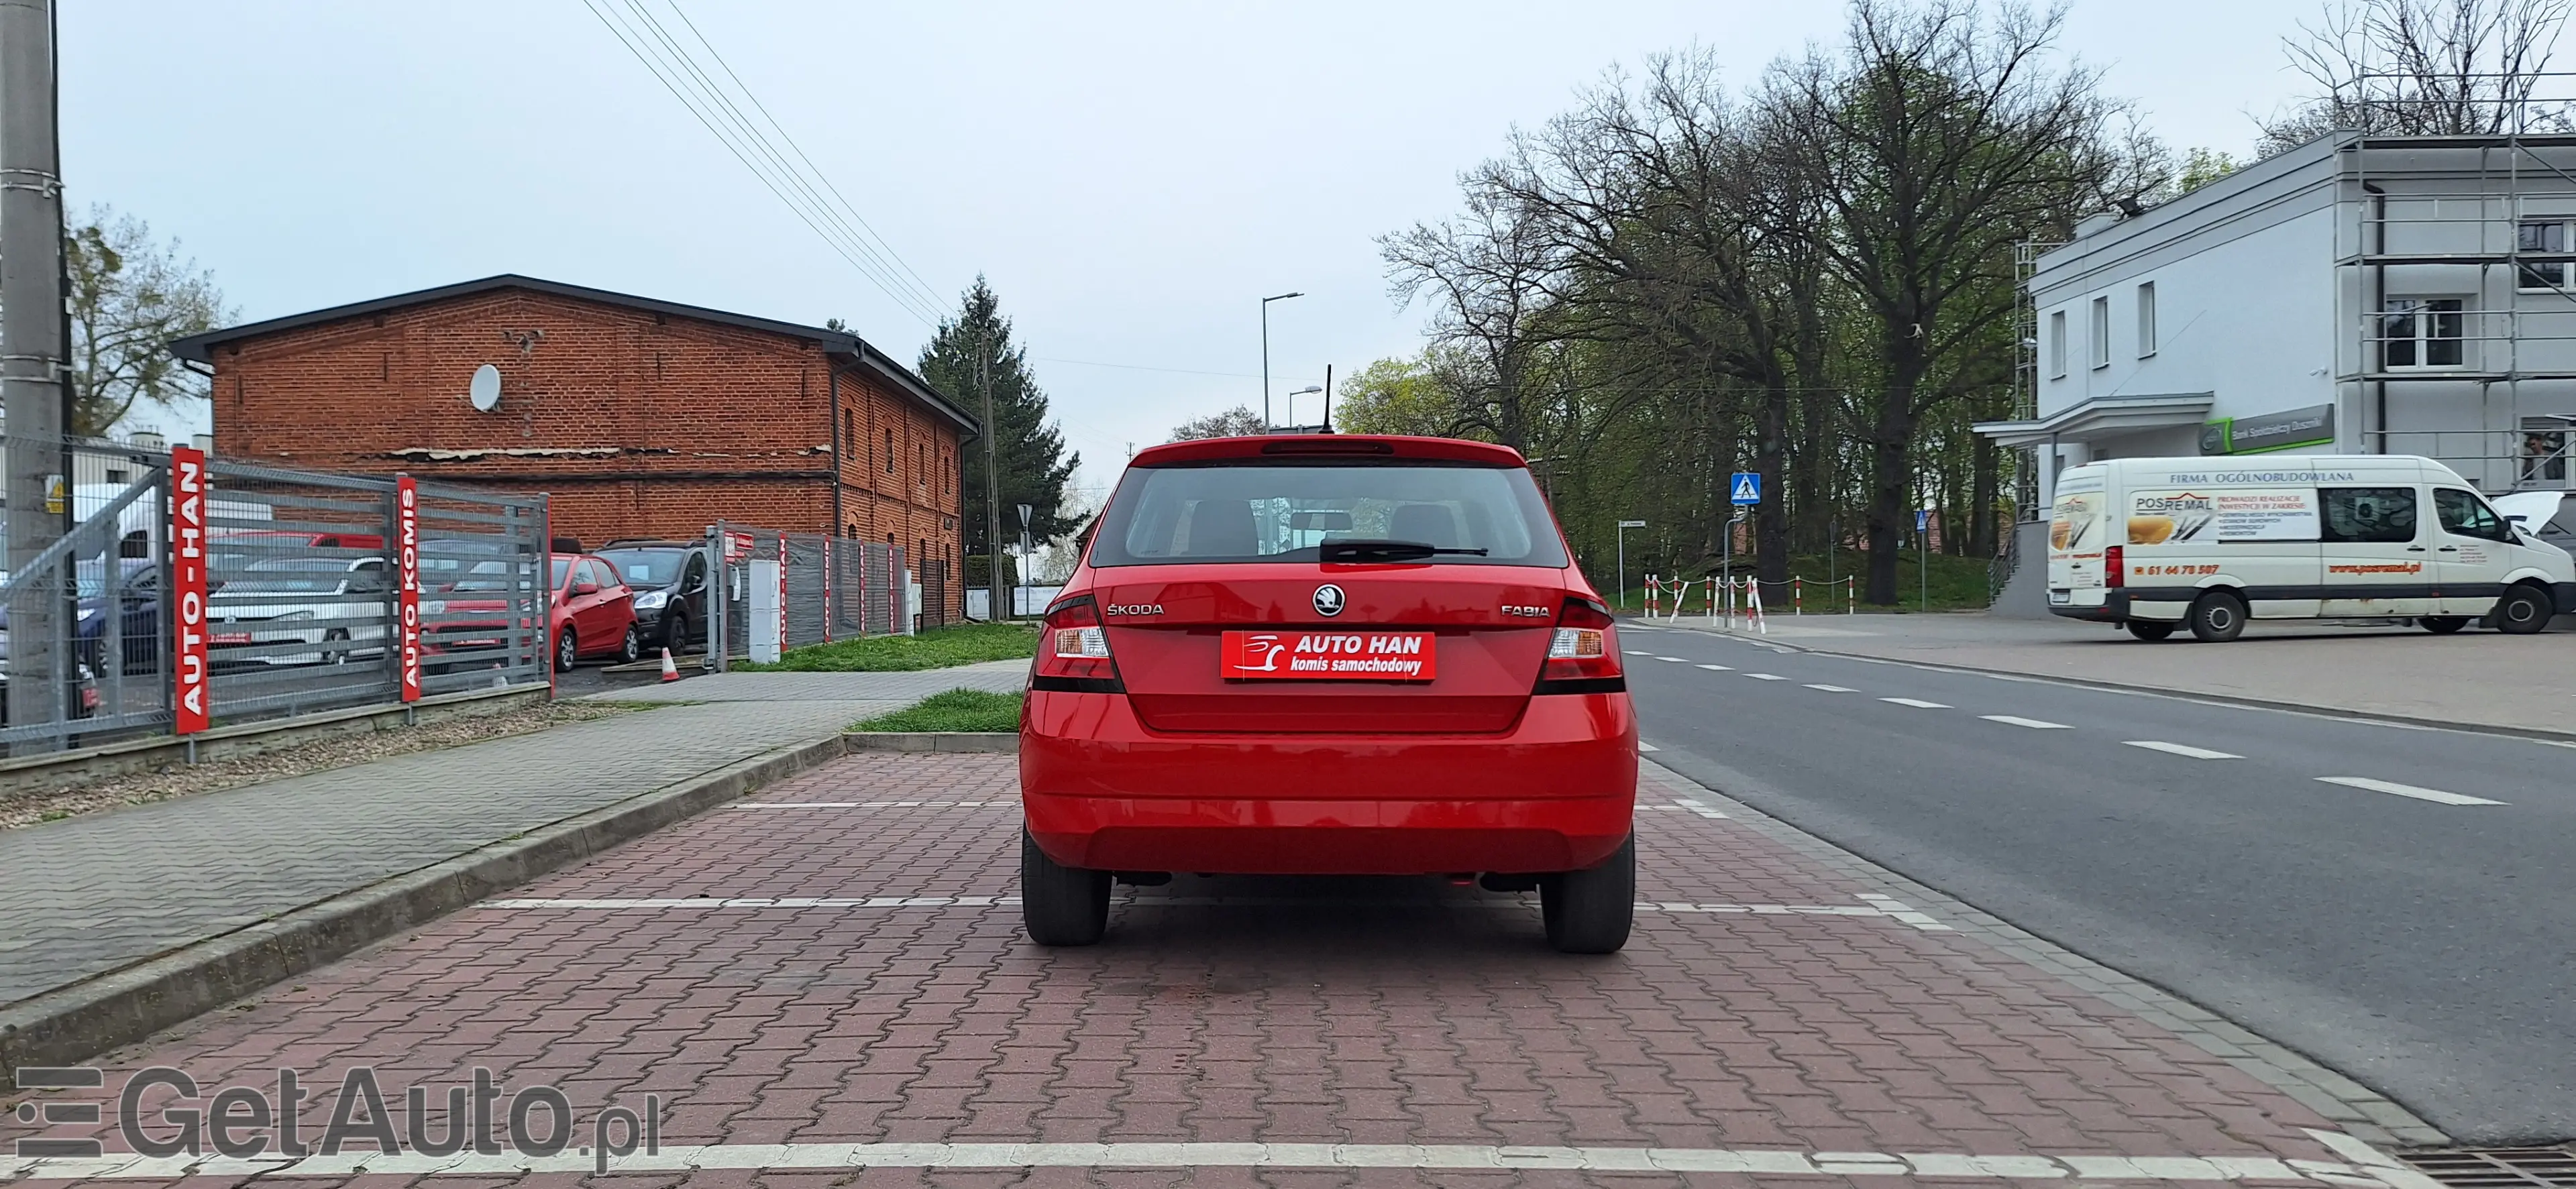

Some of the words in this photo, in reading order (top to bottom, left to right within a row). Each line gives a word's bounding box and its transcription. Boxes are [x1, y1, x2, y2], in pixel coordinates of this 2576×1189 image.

[2170, 474, 2208, 483] FIRMA
[2216, 470, 2354, 483] OGÓLNOBUDOWLANA
[180, 462, 199, 558] HAN
[402, 488, 416, 591] KOMIS
[2147, 565, 2161, 575] 61
[2165, 565, 2180, 575] 44
[1107, 604, 1165, 616] ŠKODA
[1501, 606, 1550, 617] FABIA
[182, 591, 201, 716] AUTO
[404, 604, 417, 687] AUTO
[1294, 635, 1361, 653] AUTO
[1368, 636, 1421, 655] HAN
[1290, 656, 1328, 671] komis
[1331, 657, 1422, 676] samochodowy
